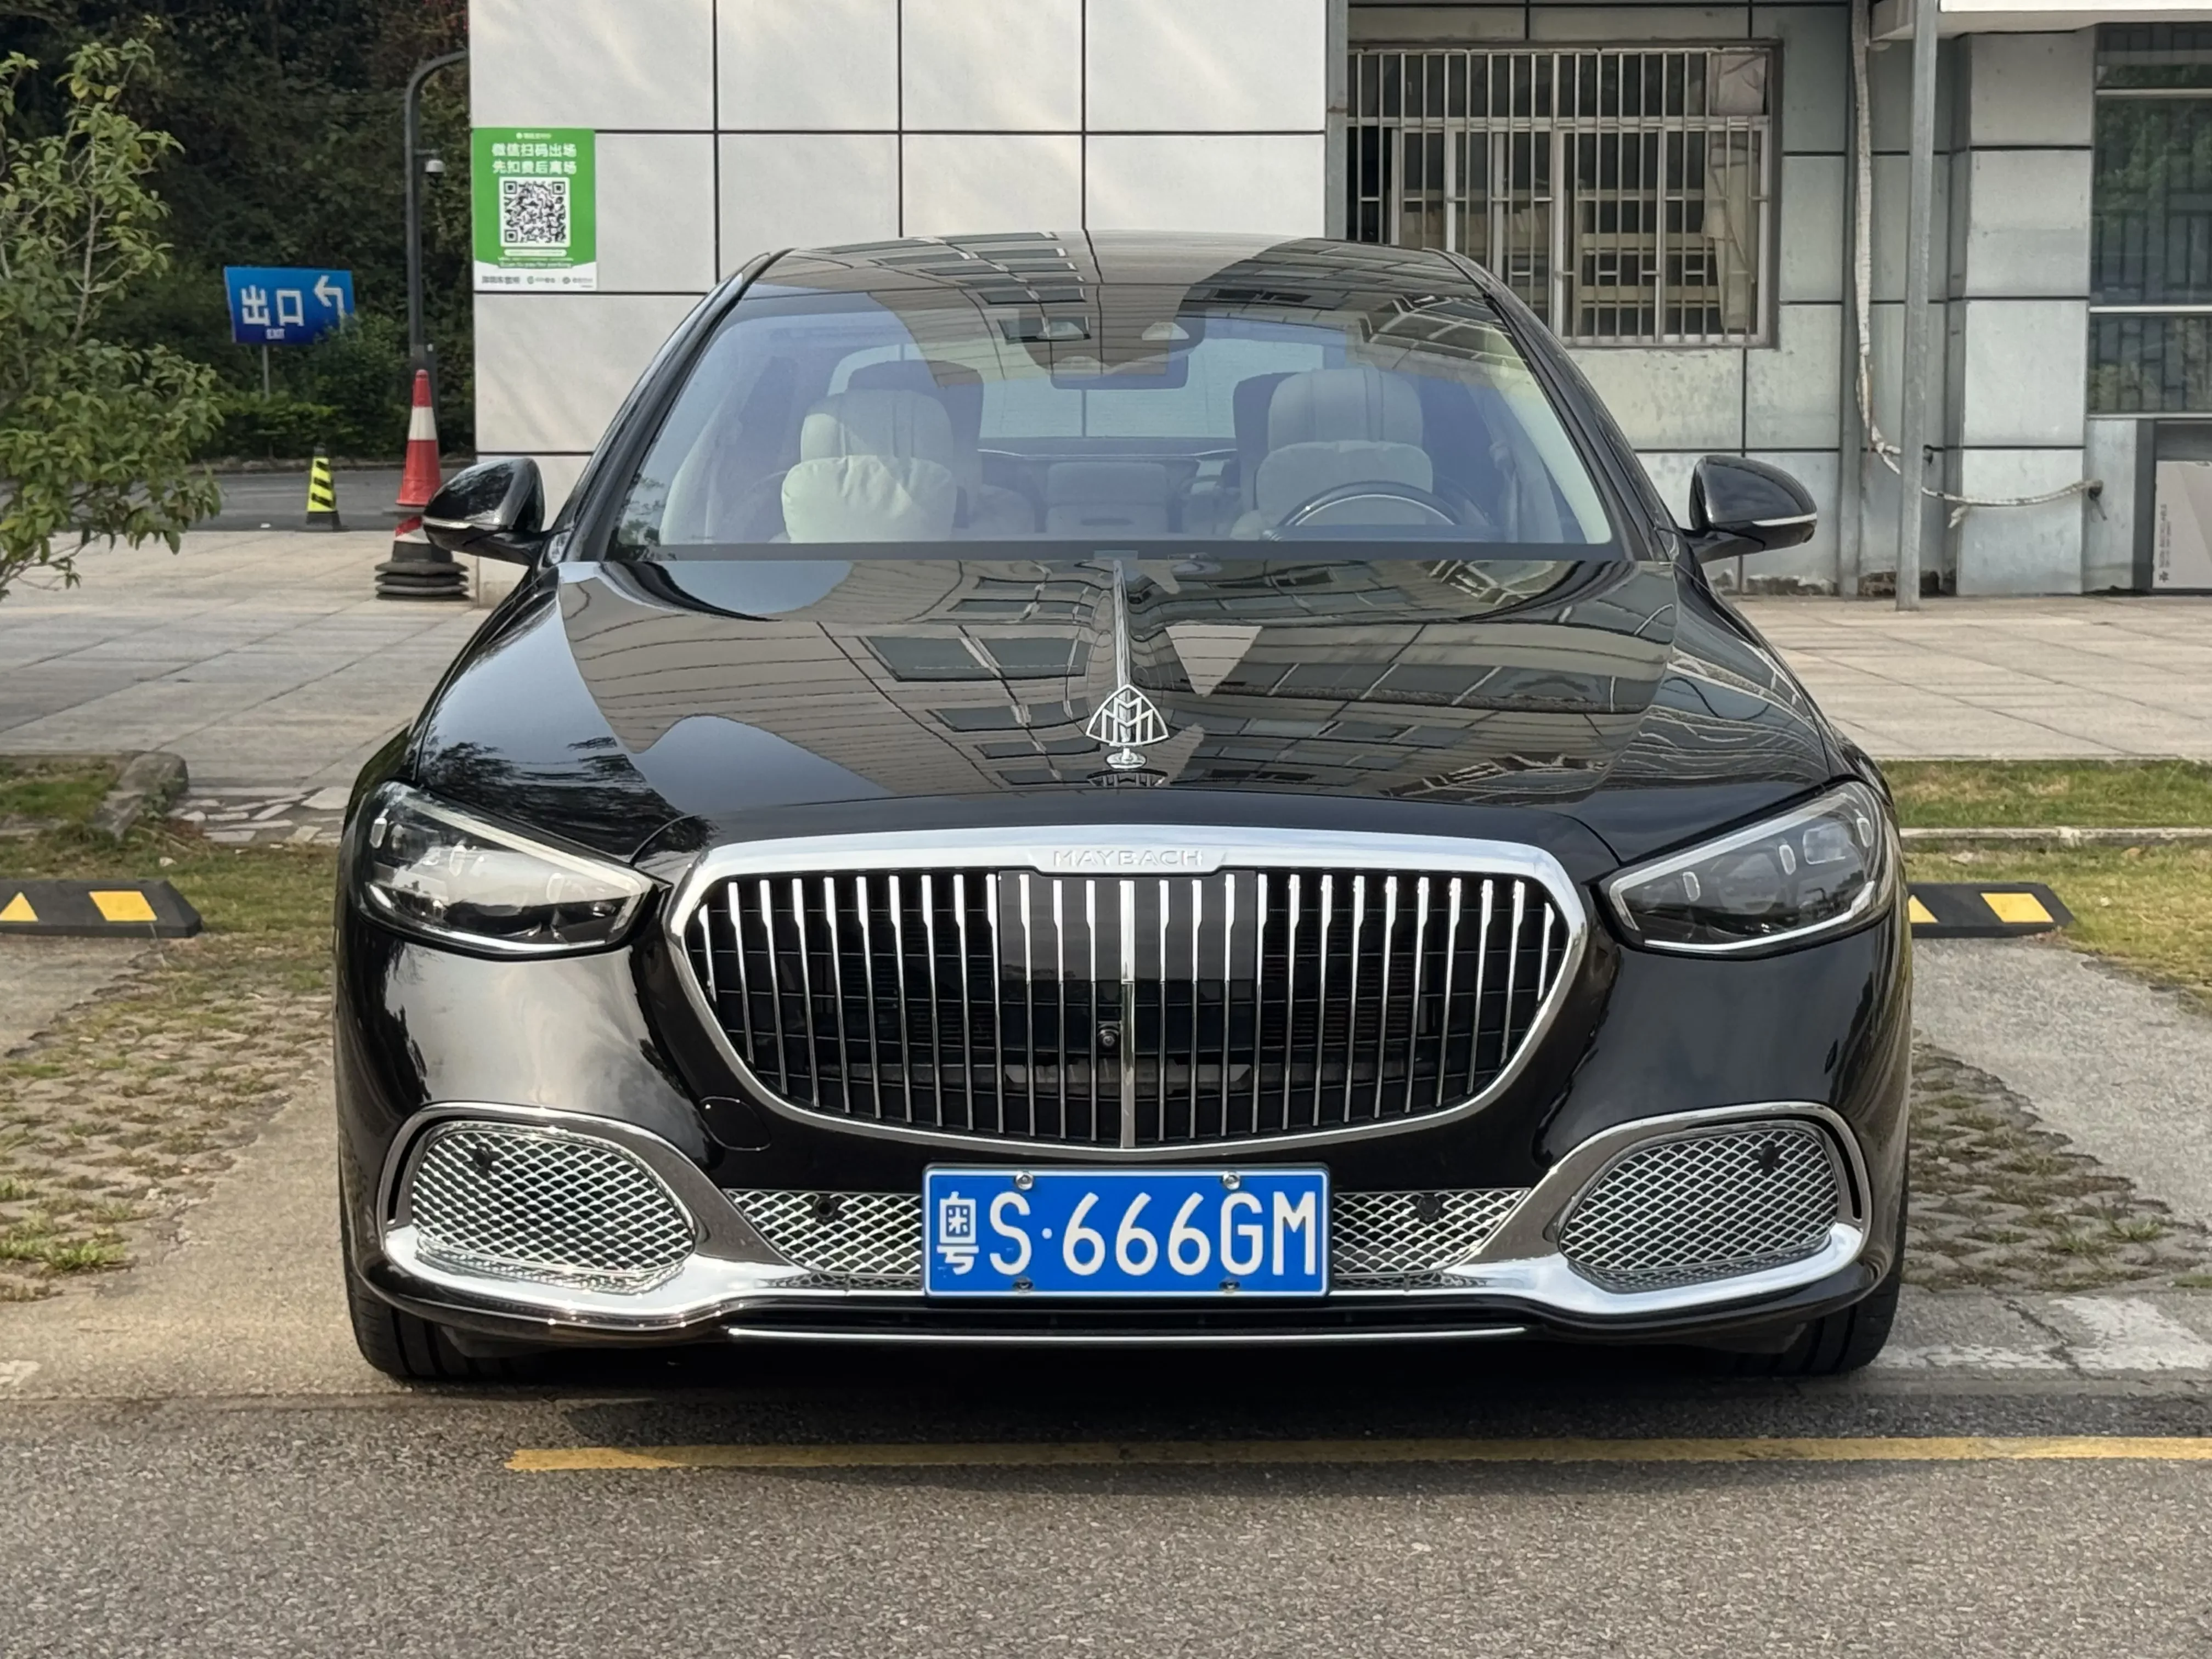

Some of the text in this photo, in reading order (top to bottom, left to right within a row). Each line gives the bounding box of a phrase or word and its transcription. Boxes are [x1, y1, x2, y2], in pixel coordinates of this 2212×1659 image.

[492, 143, 577, 157] 微信扫码出场
[241, 285, 304, 326] 出口
[1053, 850, 1203, 867] MAYBACH
